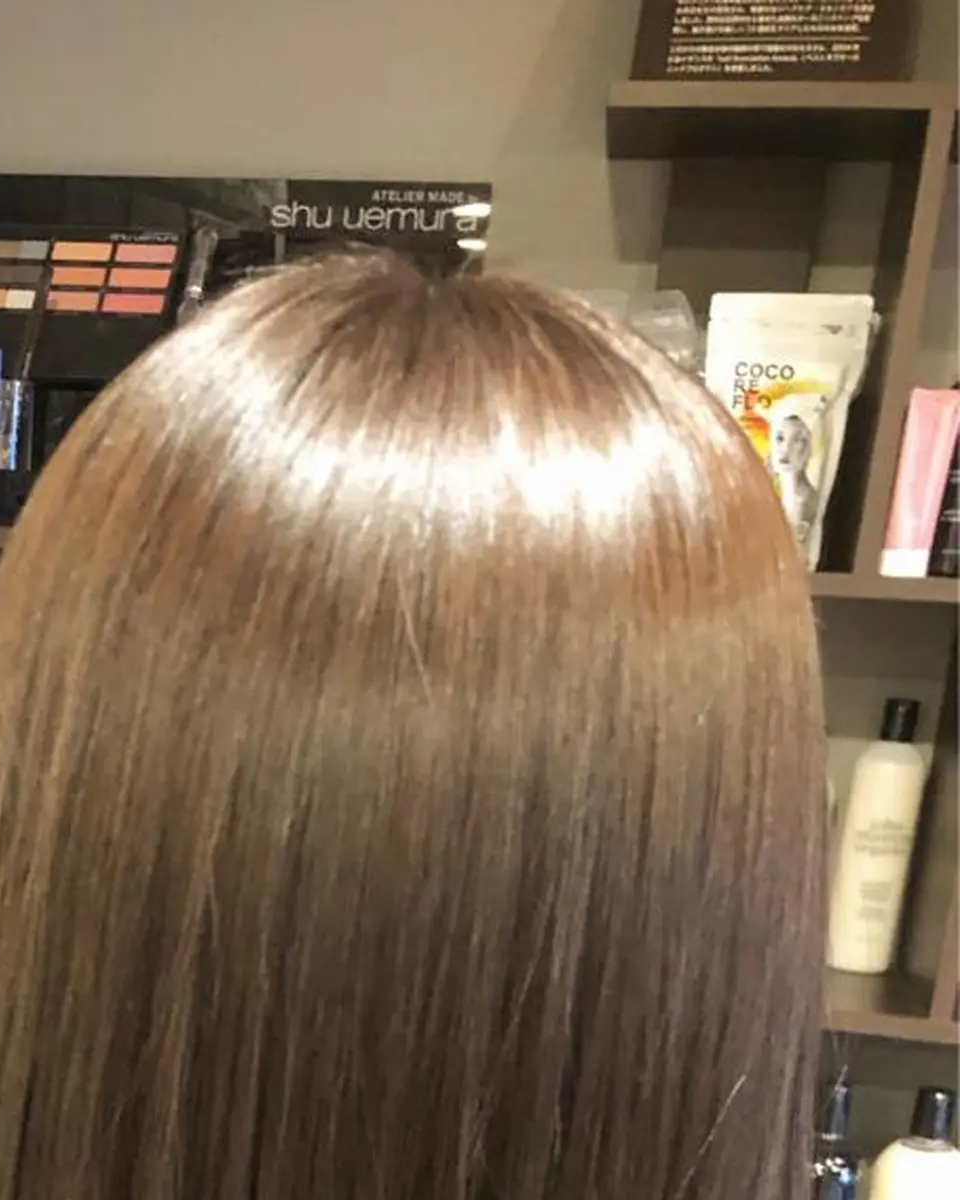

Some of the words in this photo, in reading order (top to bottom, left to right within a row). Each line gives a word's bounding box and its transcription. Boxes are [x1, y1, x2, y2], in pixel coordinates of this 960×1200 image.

[372, 189, 425, 202] ATELIER
[271, 201, 332, 229] shu
[343, 206, 477, 232] uemura
[734, 361, 795, 380] COCO
